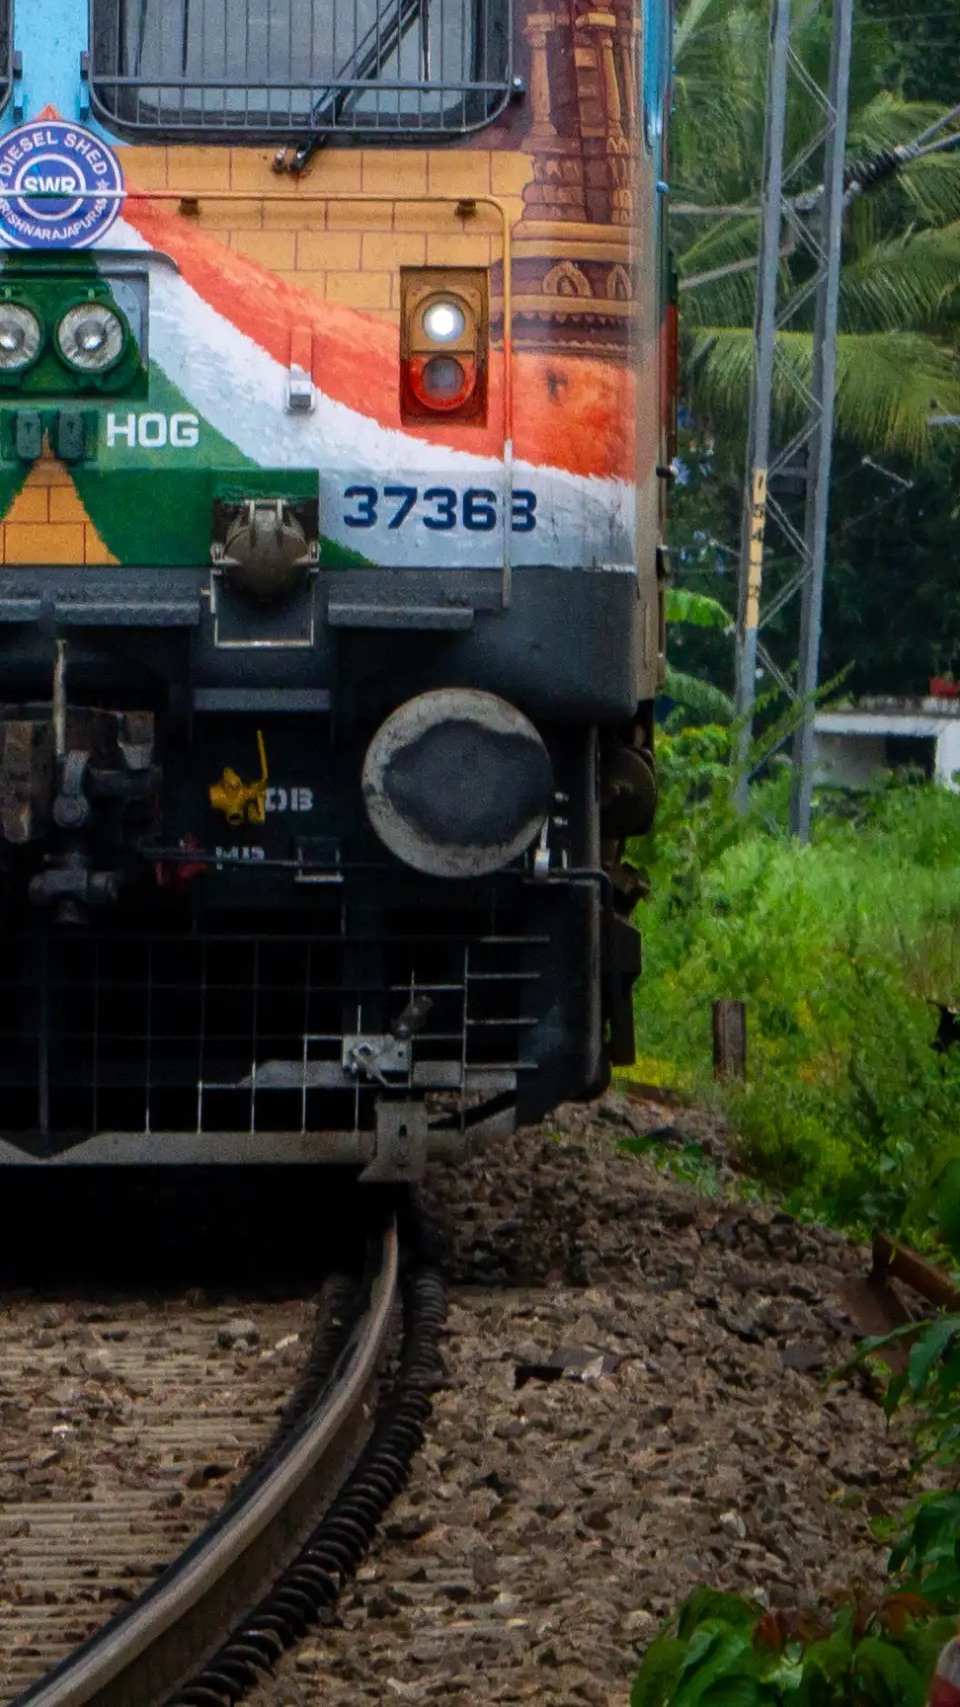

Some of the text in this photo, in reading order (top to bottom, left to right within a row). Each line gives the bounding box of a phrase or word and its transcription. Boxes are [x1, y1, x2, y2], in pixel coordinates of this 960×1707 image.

[64, 132, 108, 176] SHED
[24, 175, 77, 194] SWR
[106, 412, 200, 448] HOG
